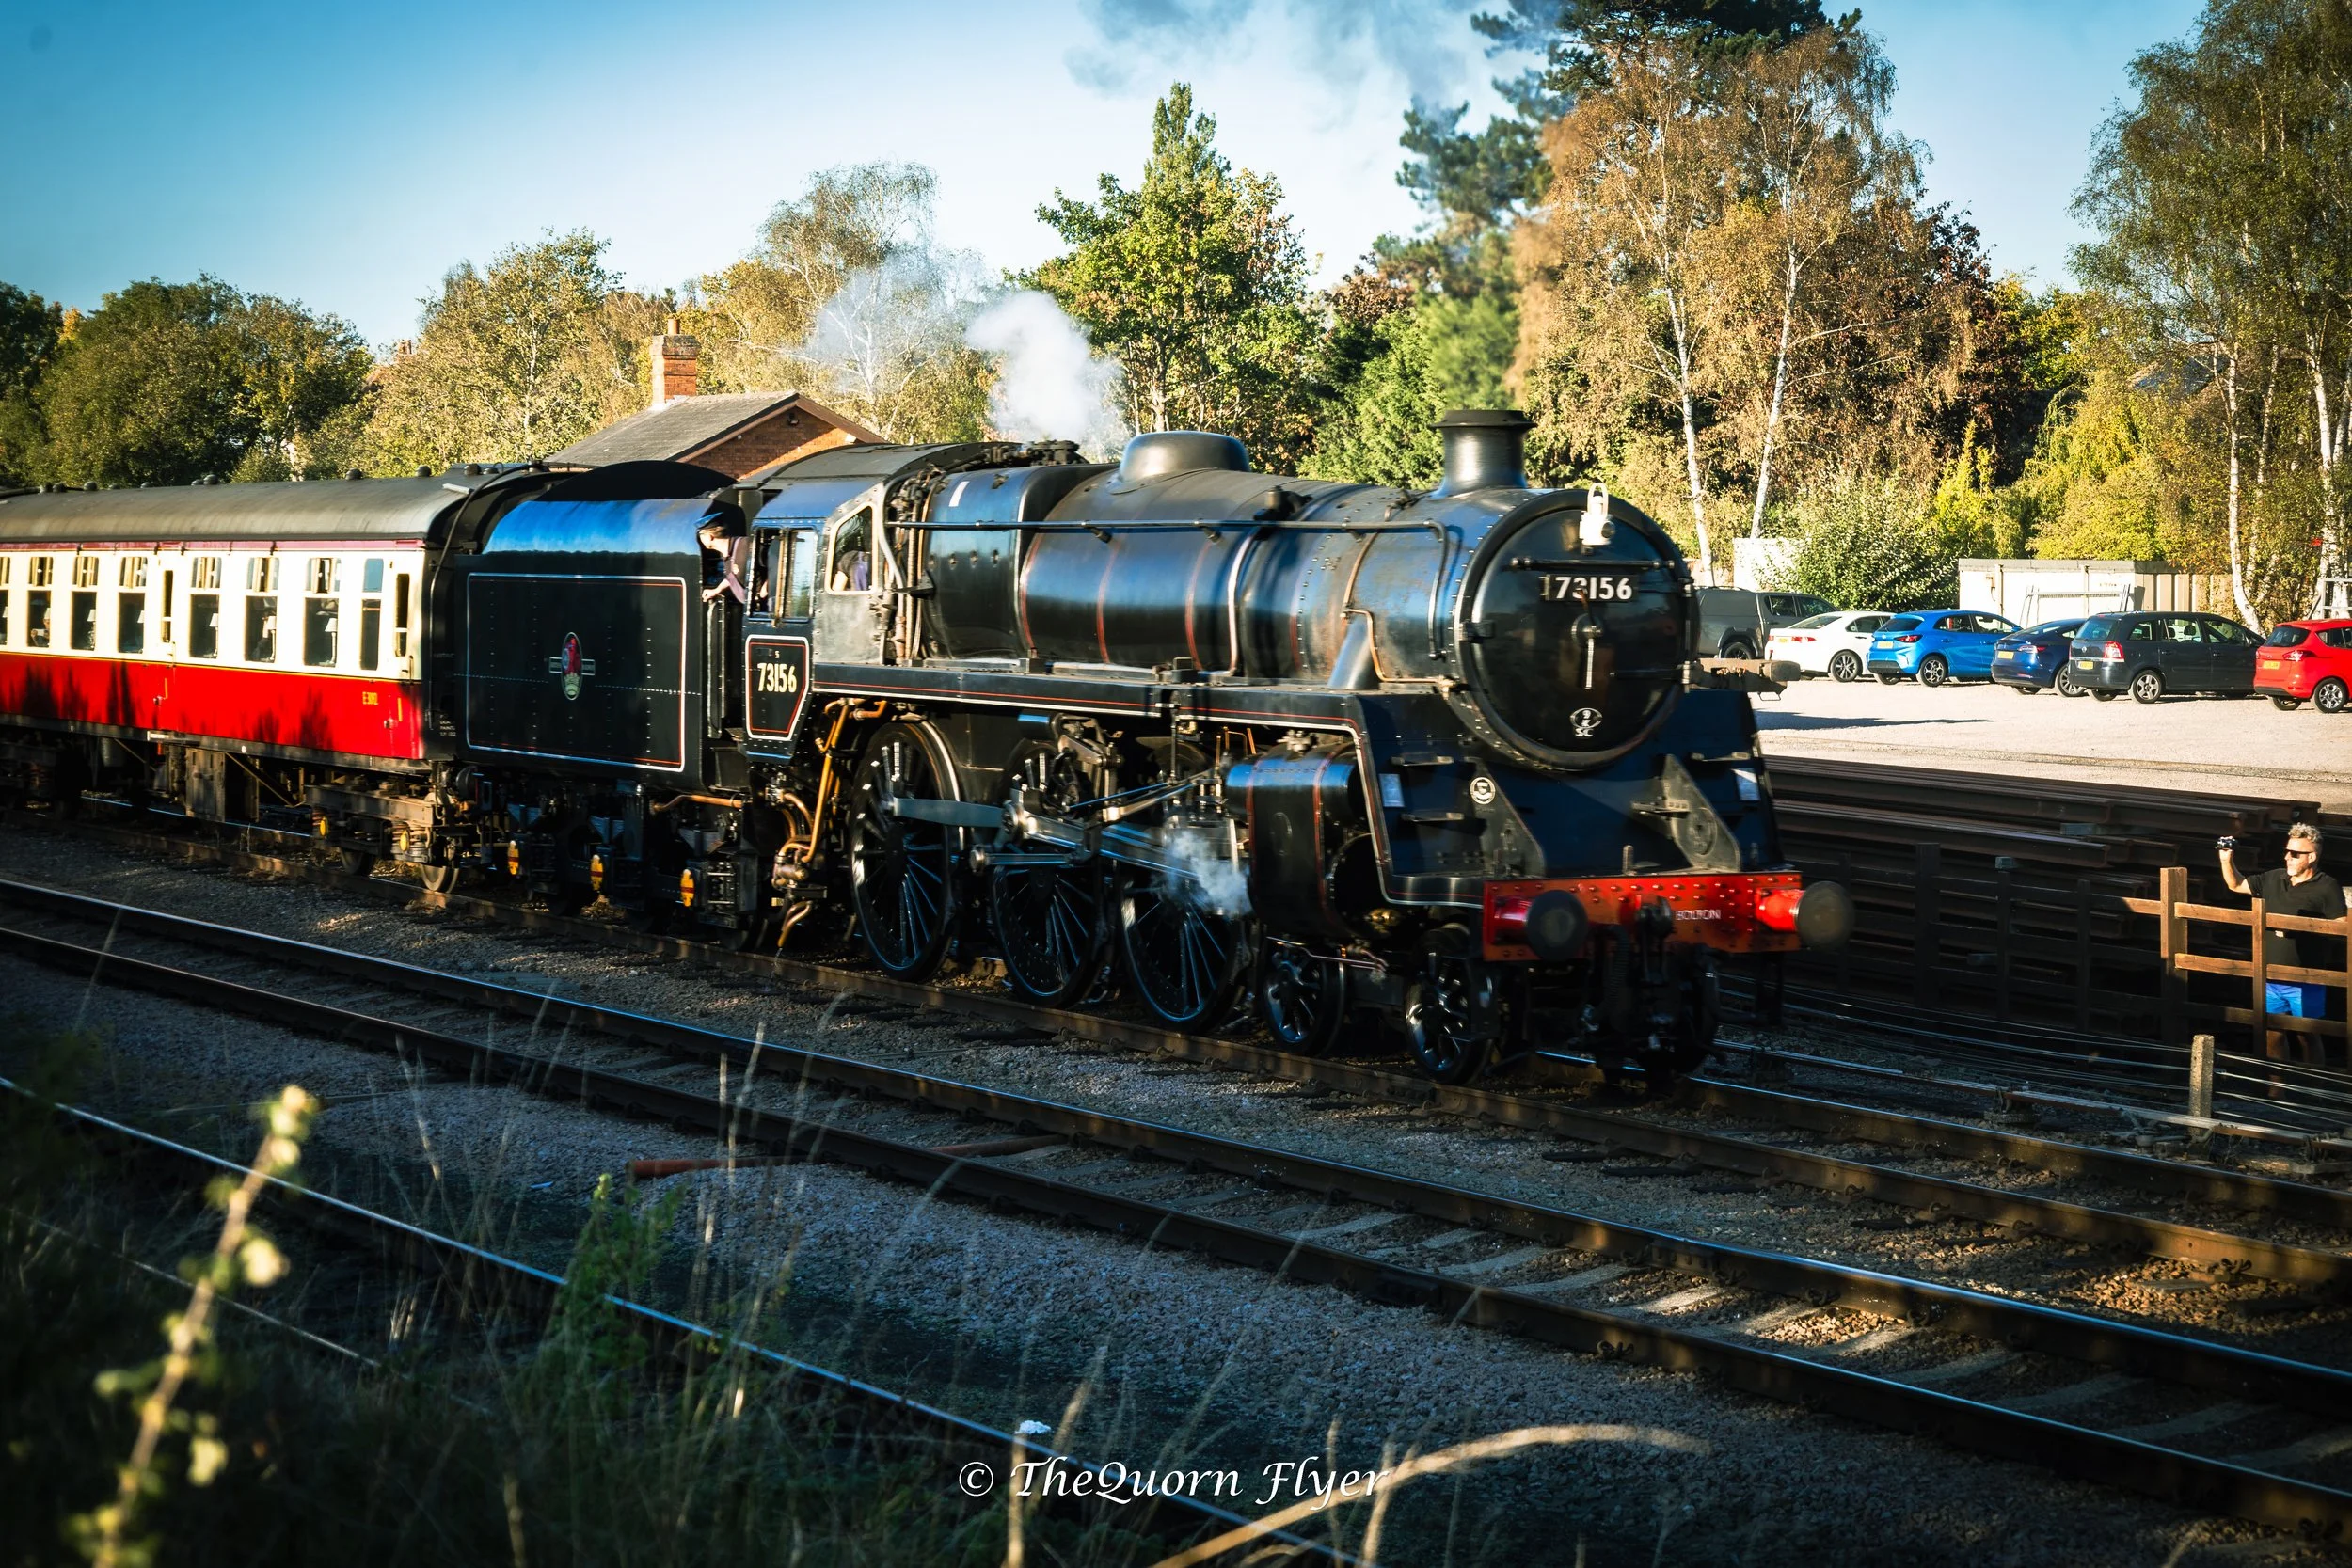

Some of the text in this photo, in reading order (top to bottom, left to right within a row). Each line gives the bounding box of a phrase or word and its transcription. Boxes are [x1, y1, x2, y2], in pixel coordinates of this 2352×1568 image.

[1555, 577, 1632, 600] 73156
[757, 662, 797, 692] 73156
[1576, 728, 1594, 737] SC
[1676, 910, 1721, 921] BOLTON
